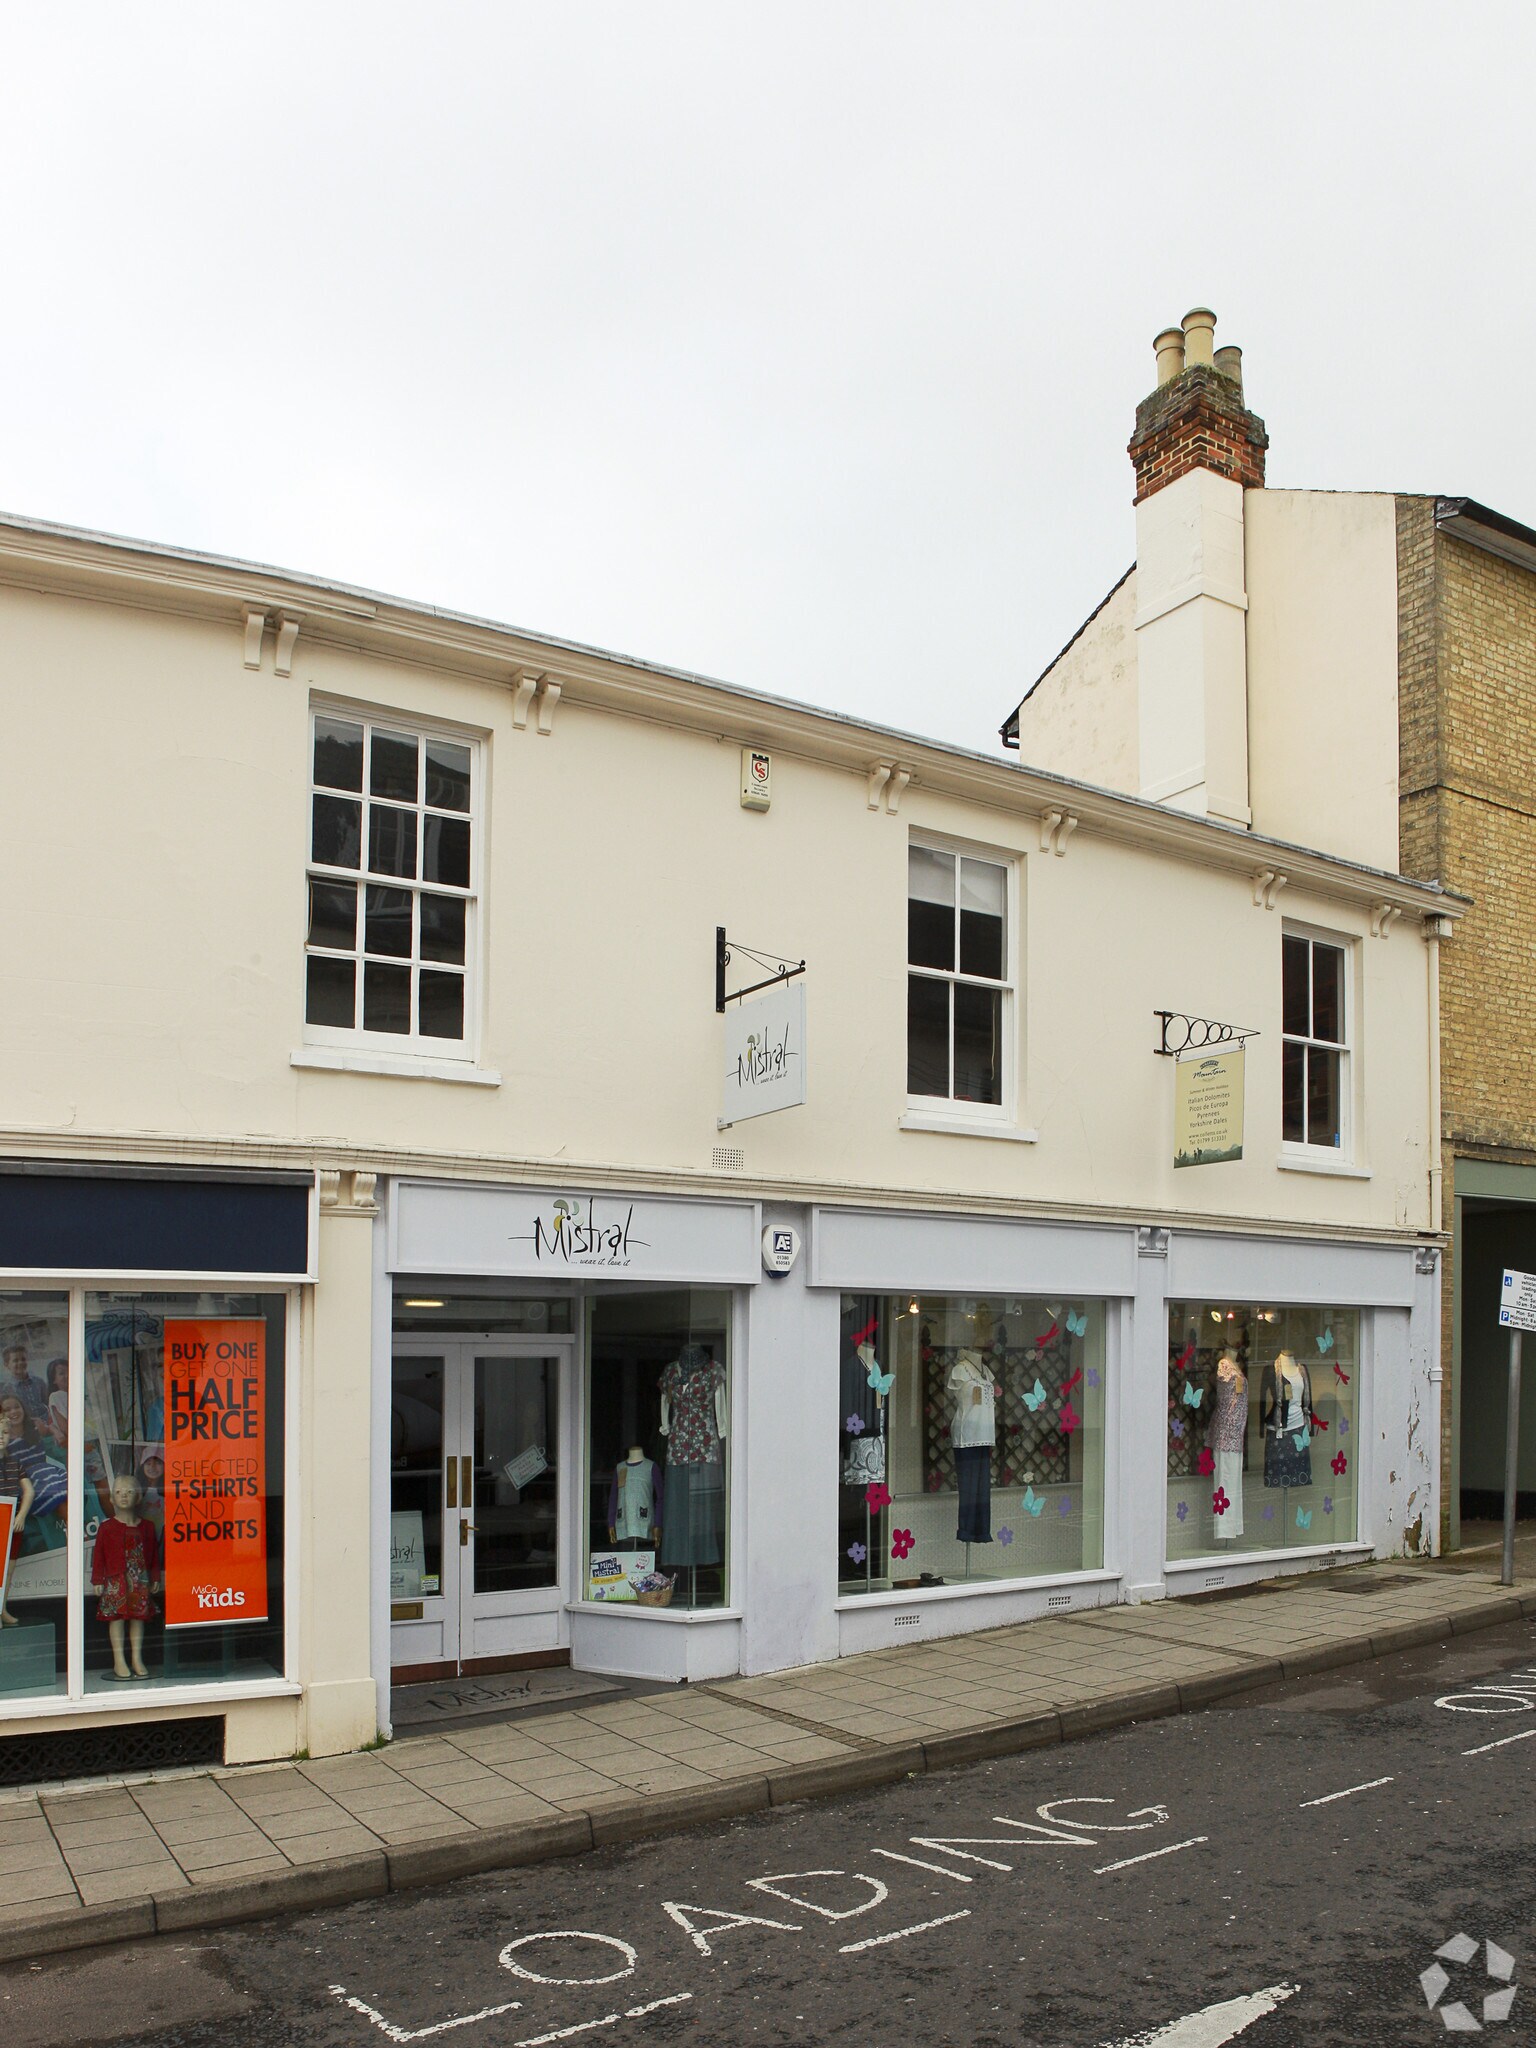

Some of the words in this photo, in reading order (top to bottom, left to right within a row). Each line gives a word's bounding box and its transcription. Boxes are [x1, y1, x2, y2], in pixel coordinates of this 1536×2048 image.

[726, 1022, 799, 1087] Mistral
[1204, 1093, 1230, 1101] Dolomites
[1189, 1120, 1212, 1128] Yorkshire
[1197, 1111, 1219, 1119] Pyrenees
[508, 1197, 651, 1262] Mistral
[172, 1343, 210, 1360] BUY
[216, 1342, 258, 1359] ONE
[169, 1360, 207, 1378] GET
[214, 1360, 258, 1377] ONE
[171, 1378, 258, 1411] HALF
[171, 1410, 258, 1441] PRICE
[171, 1458, 259, 1478] SELECTED
[172, 1476, 259, 1500] T-SHIRTS
[172, 1500, 225, 1521] AND
[173, 1519, 258, 1543] SHORTS
[594, 1566, 620, 1577] Mistral
[599, 1560, 615, 1569] Mini
[39, 1578, 65, 1587] MOBILE
[191, 1584, 218, 1595] M&Co
[328, 1797, 1168, 2042] LOADING
